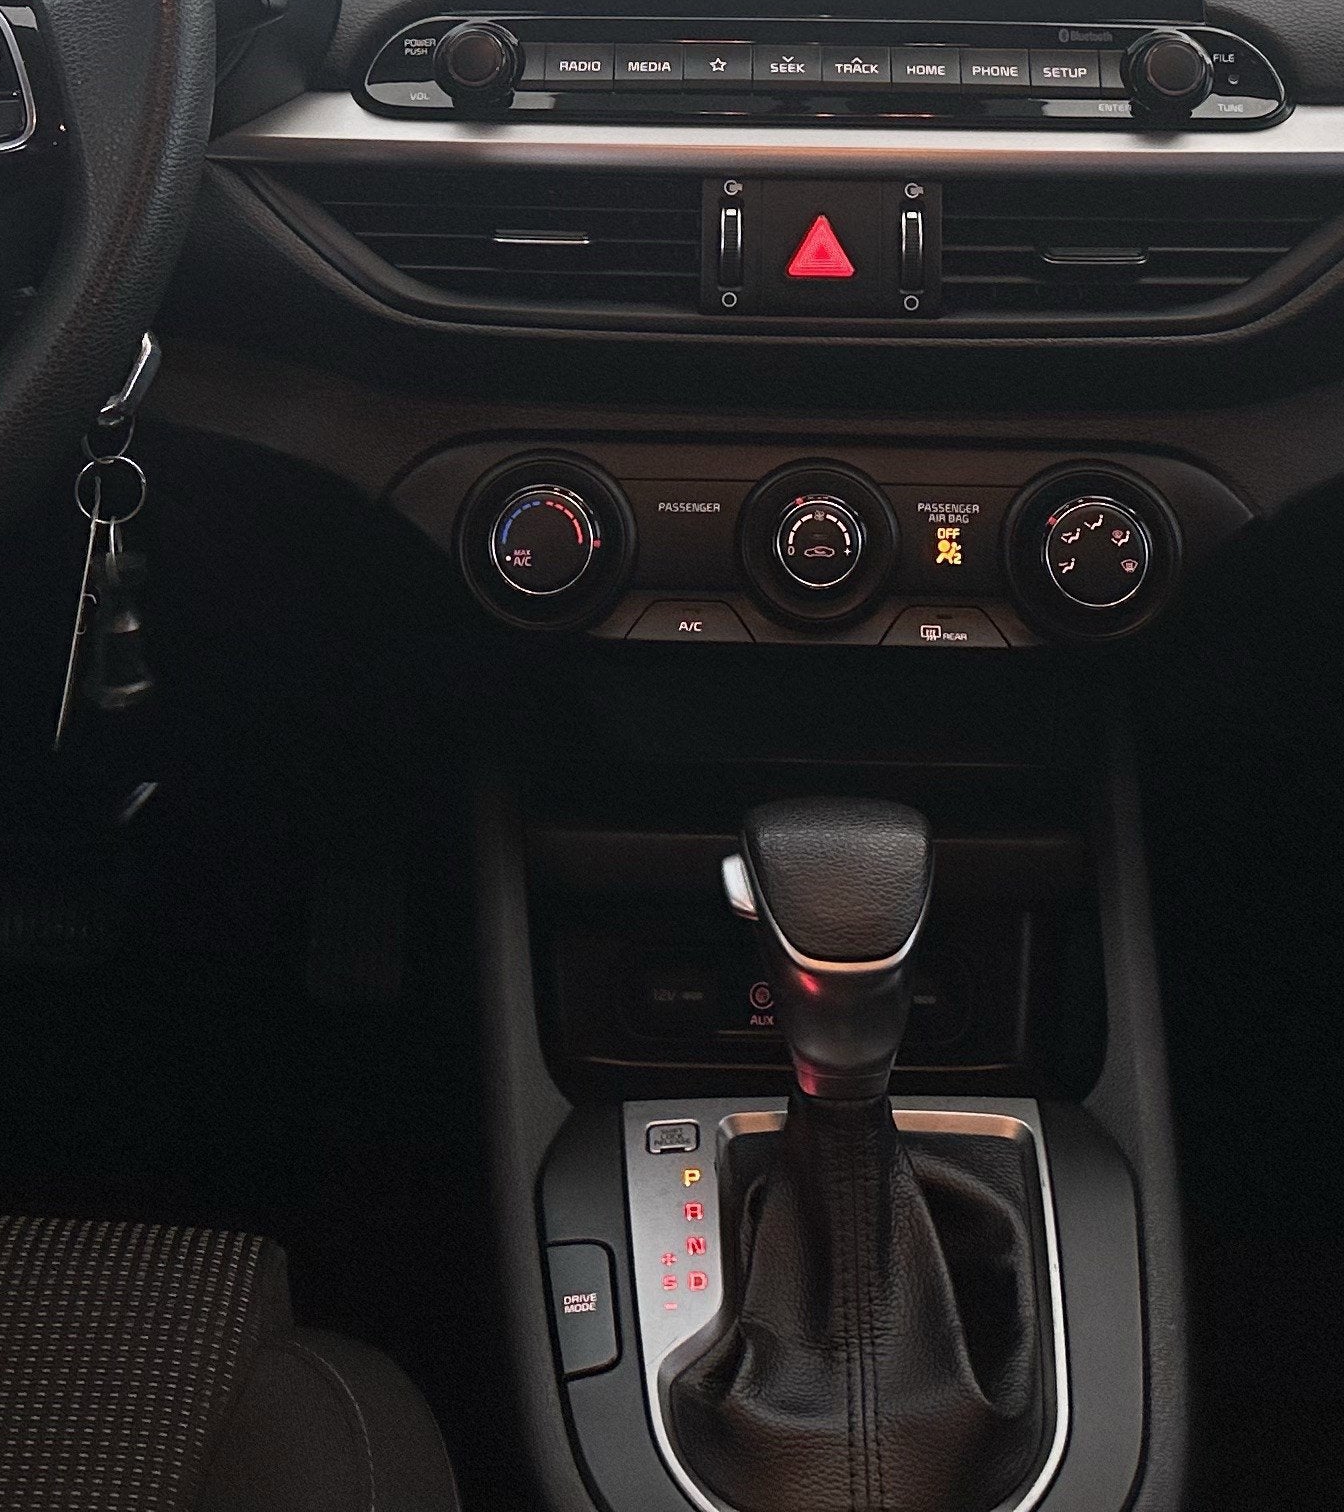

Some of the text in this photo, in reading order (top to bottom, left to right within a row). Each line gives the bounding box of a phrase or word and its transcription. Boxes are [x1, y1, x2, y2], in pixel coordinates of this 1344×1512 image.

[404, 38, 436, 48] POWER
[405, 47, 428, 56] PUSH
[1213, 53, 1235, 63] FILE
[559, 61, 602, 72] RADIO
[628, 62, 671, 71] MEDIA
[770, 62, 805, 74] SEEK
[834, 62, 879, 74] TRACK
[906, 64, 946, 76] HOME
[972, 65, 1019, 77] PHONE
[1043, 67, 1087, 78] SETUP
[409, 91, 430, 101] VOL
[1218, 103, 1244, 113] TUNE
[658, 502, 721, 513] PASSENGER
[917, 502, 980, 514] PASSENGER
[928, 513, 970, 523] AIR BAG
[937, 527, 961, 540] OFF
[513, 556, 532, 567] A/C
[678, 621, 703, 632] A/C
[750, 1014, 774, 1025] AUX
[683, 1169, 701, 1187] P
[687, 1237, 706, 1255] N
[663, 1275, 678, 1290] S
[688, 1271, 708, 1291] D
[563, 1292, 598, 1305] DRIVE
[564, 1302, 597, 1314] MODE
